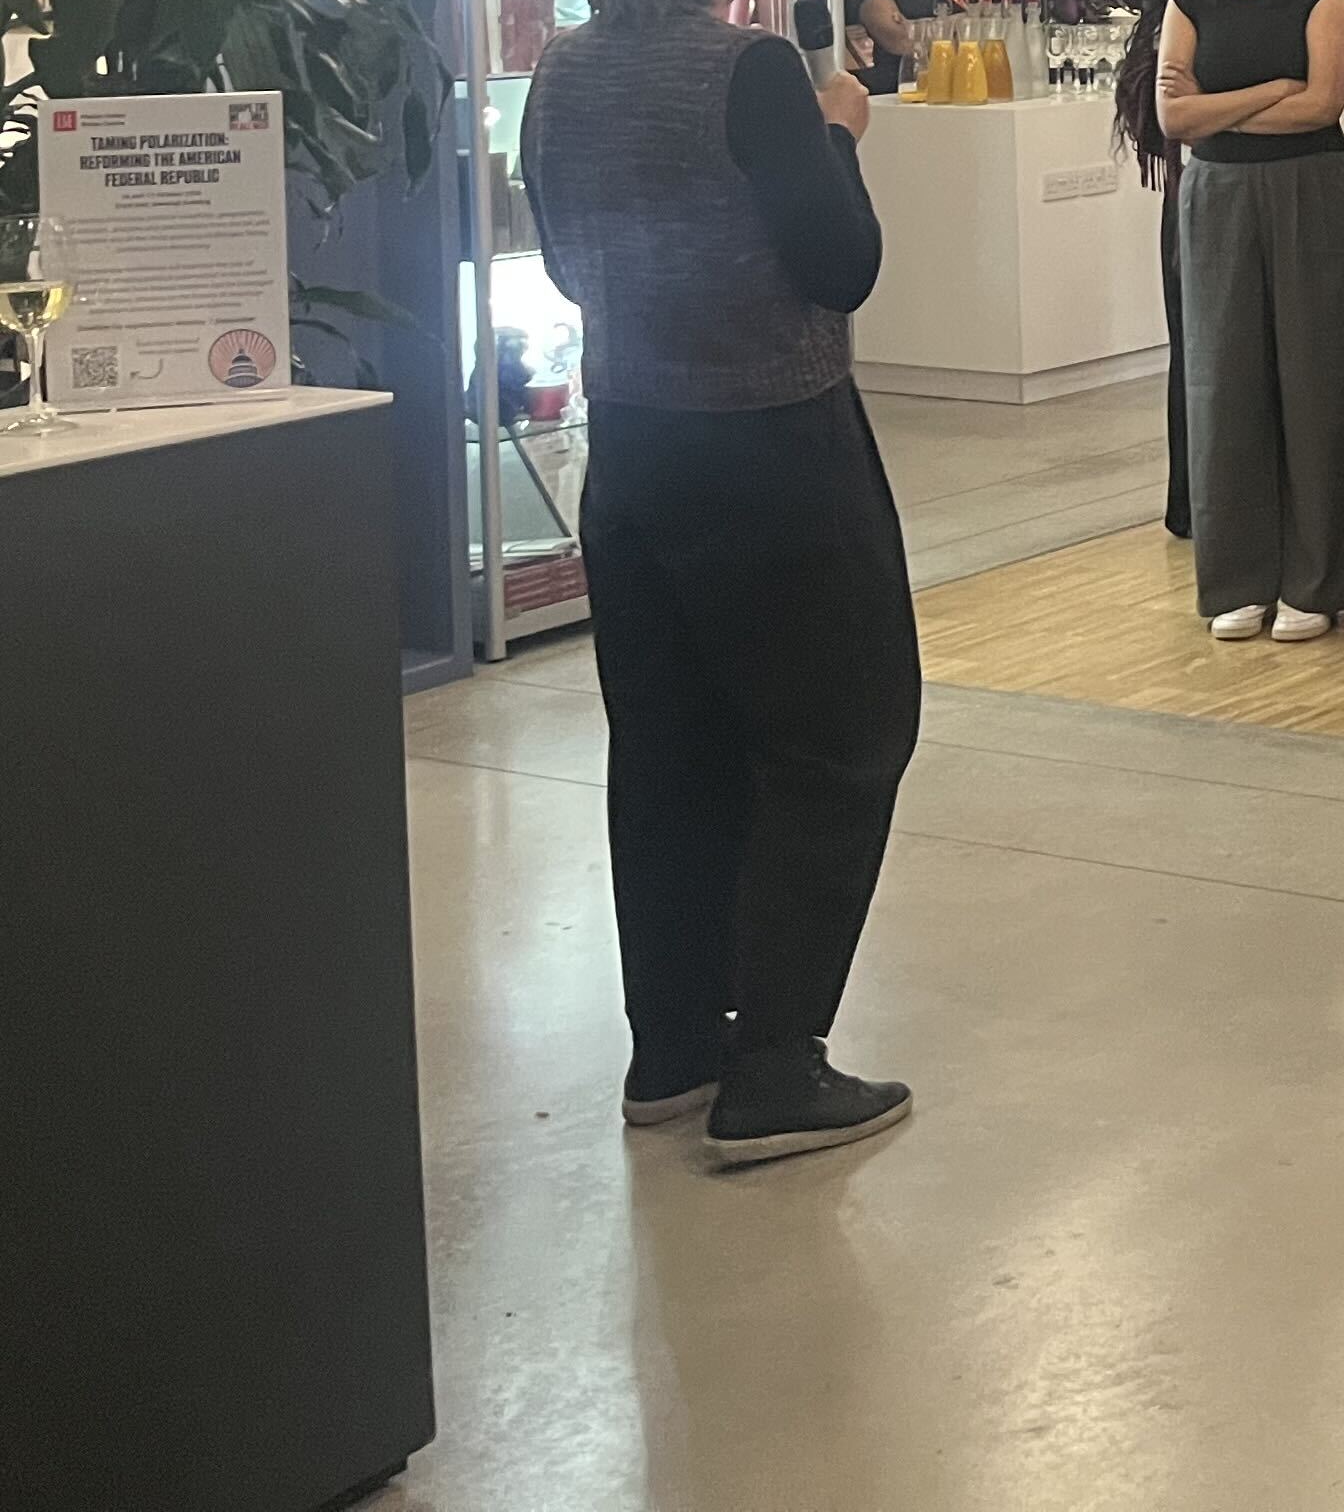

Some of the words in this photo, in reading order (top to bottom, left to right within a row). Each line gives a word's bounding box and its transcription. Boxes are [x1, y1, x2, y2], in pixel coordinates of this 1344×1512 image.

[91, 136, 137, 151] TAMING
[139, 132, 229, 149] POLARIZATION:
[79, 153, 151, 170] REFORMING
[154, 152, 175, 167] THE
[178, 149, 241, 166] AMERICAN
[105, 171, 158, 187] FEDERAL
[160, 168, 220, 185] REPUBLIC
